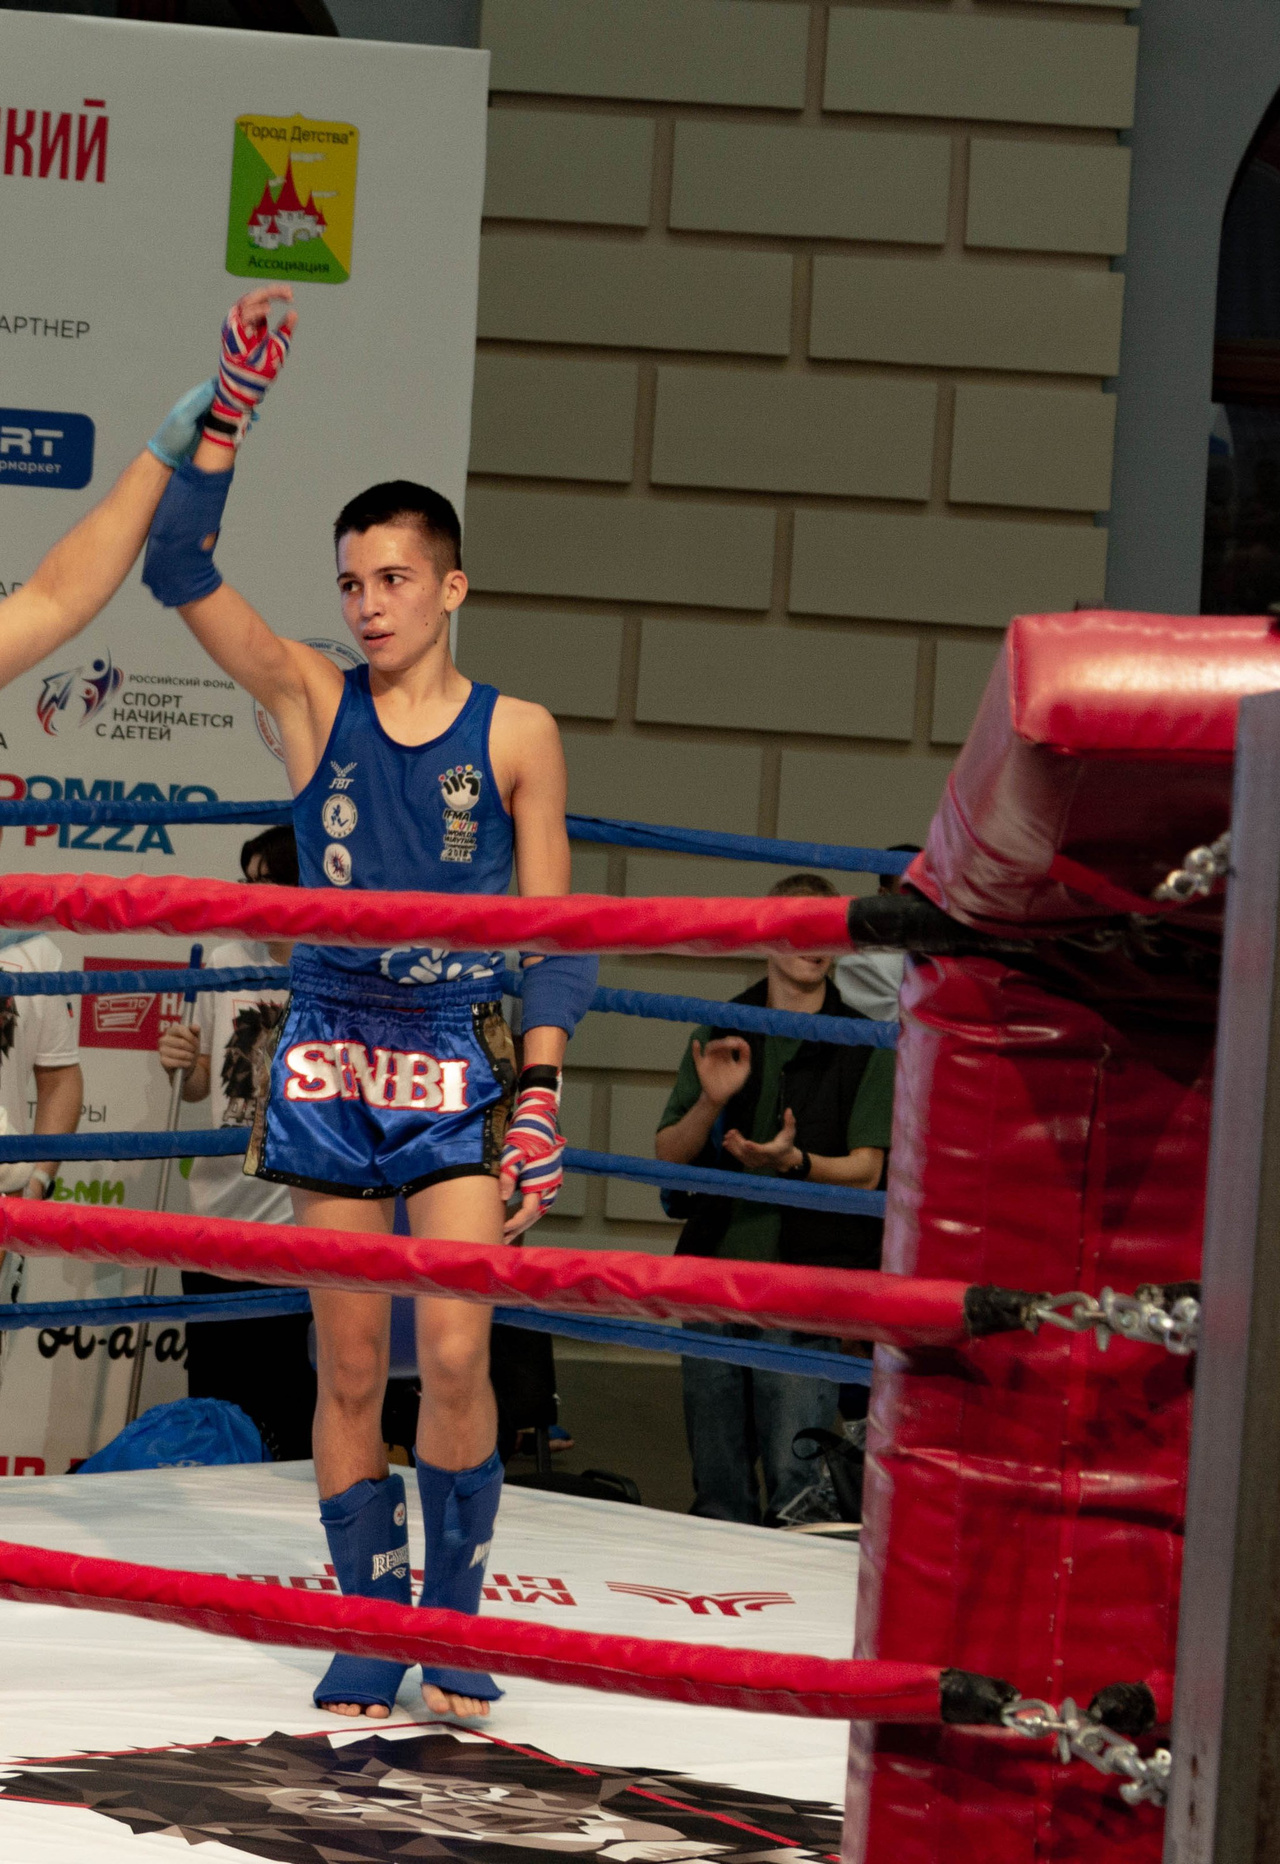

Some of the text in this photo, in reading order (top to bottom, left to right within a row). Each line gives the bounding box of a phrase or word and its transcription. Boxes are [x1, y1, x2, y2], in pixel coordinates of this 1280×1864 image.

[247, 254, 330, 274] Ассоциация
[128, 673, 236, 690] РОССИЙСКИЙ ФОНД
[122, 692, 183, 708] СПОРТ
[112, 707, 234, 729] НАЧИНАЕТСЯ
[95, 723, 172, 741] С ДЕТЕЙ
[329, 778, 355, 789] FBT
[443, 809, 471, 821] IFMA
[446, 819, 479, 832] YOUTH
